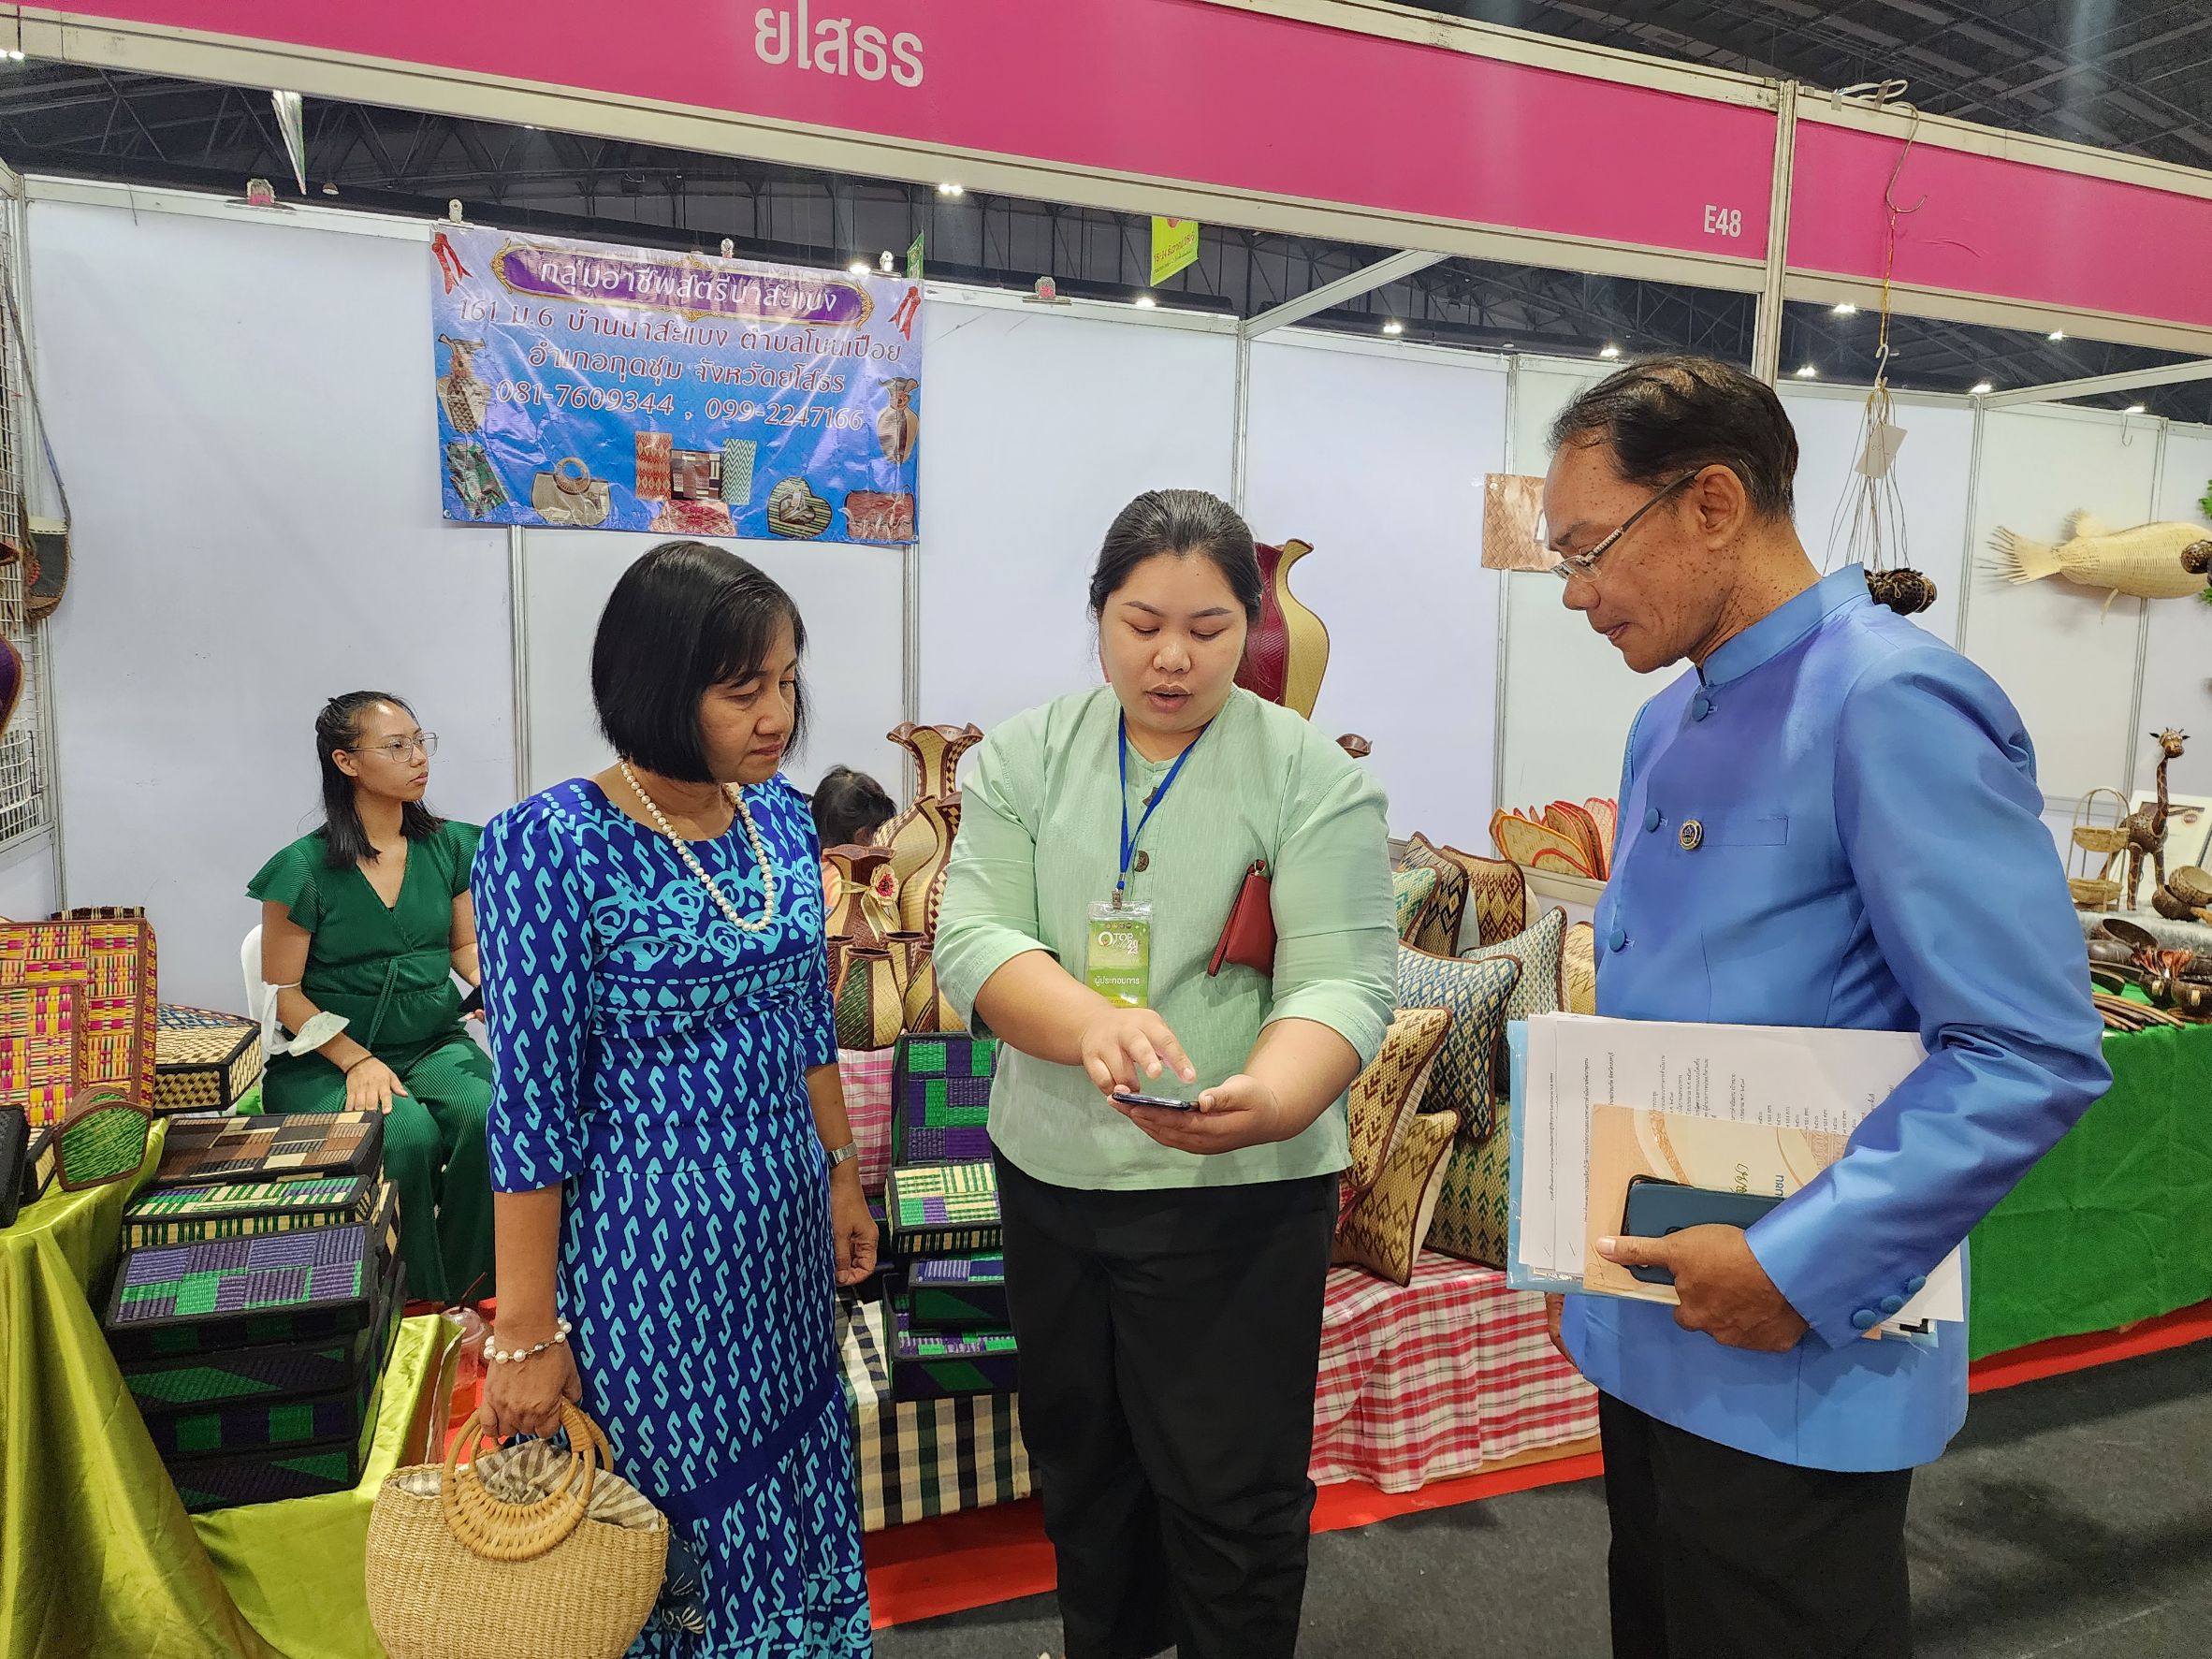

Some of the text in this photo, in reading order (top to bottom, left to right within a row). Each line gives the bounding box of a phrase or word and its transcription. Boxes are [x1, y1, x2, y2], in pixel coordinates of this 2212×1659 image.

[755, 0, 924, 87] ยโสธร
[1704, 204, 1741, 238] E48
[541, 259, 837, 313] กลุ่มอาชีพสตรีนาสะแบง
[459, 297, 901, 363] 161 ม.6 บ้านนาสะแบง ตำบลโนนเปือย
[528, 341, 846, 393] อำเภอกุดชุม จังหวัดยโสธร
[497, 379, 675, 415] 081-7609344
[705, 397, 864, 430] 099-2247166
